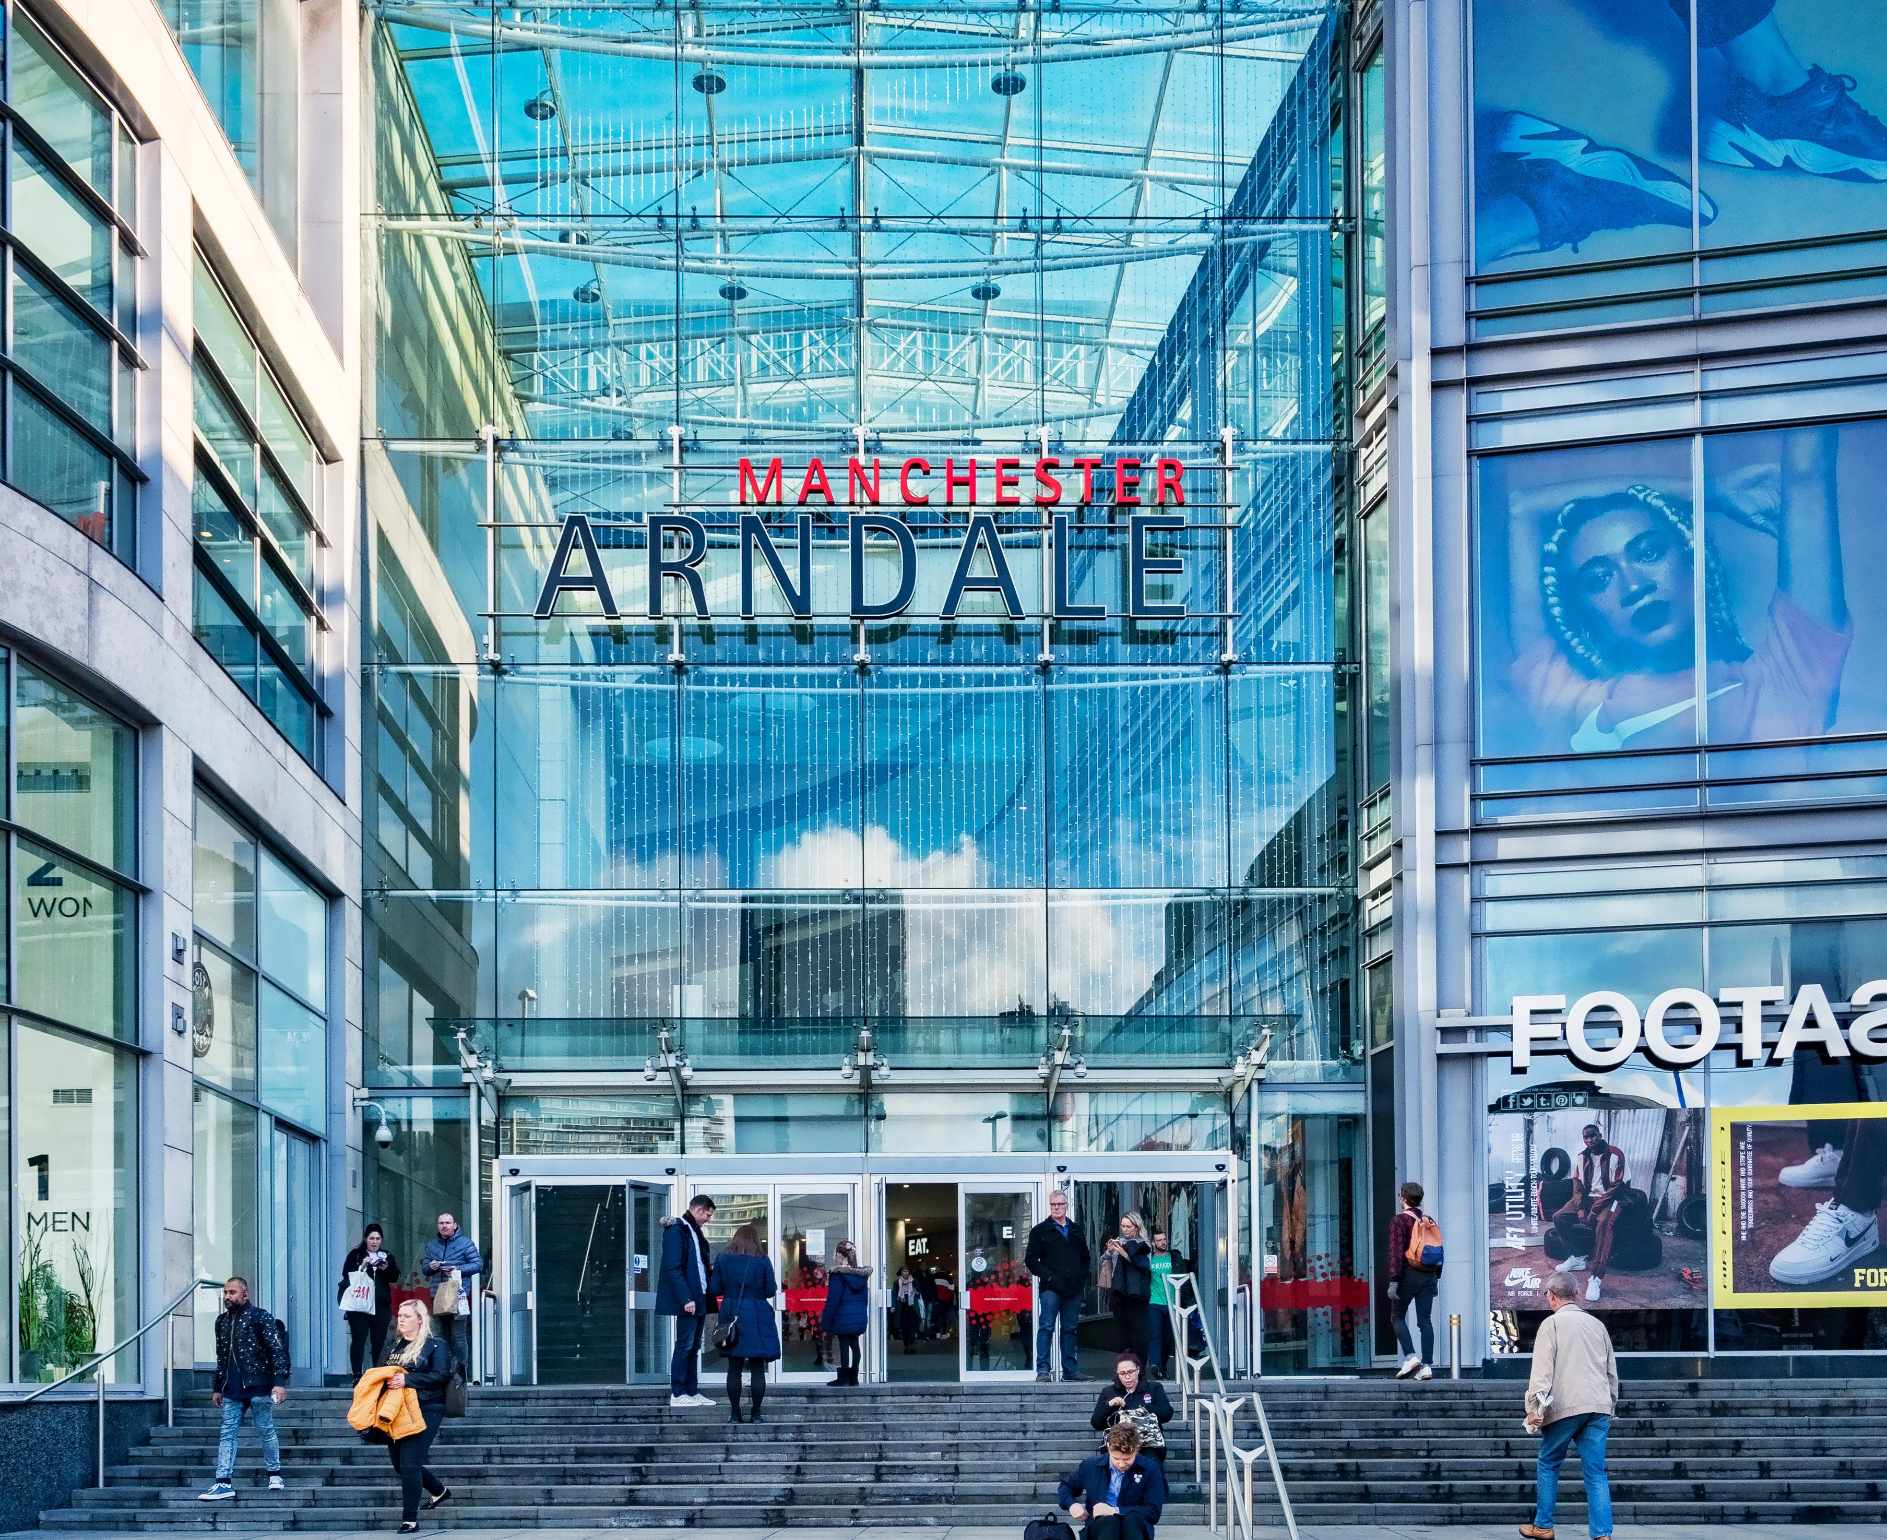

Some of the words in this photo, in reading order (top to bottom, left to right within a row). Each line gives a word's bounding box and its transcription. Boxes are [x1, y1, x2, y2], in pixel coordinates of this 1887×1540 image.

[738, 457, 1186, 507] MANCHESTER
[533, 513, 1188, 621] ARNDALE
[28, 1154, 49, 1201] 1
[1505, 1170, 1525, 1220] UTILITY
[27, 1211, 90, 1232] MEN
[1505, 1226, 1526, 1251] AF1
[908, 1238, 930, 1256] EAT.
